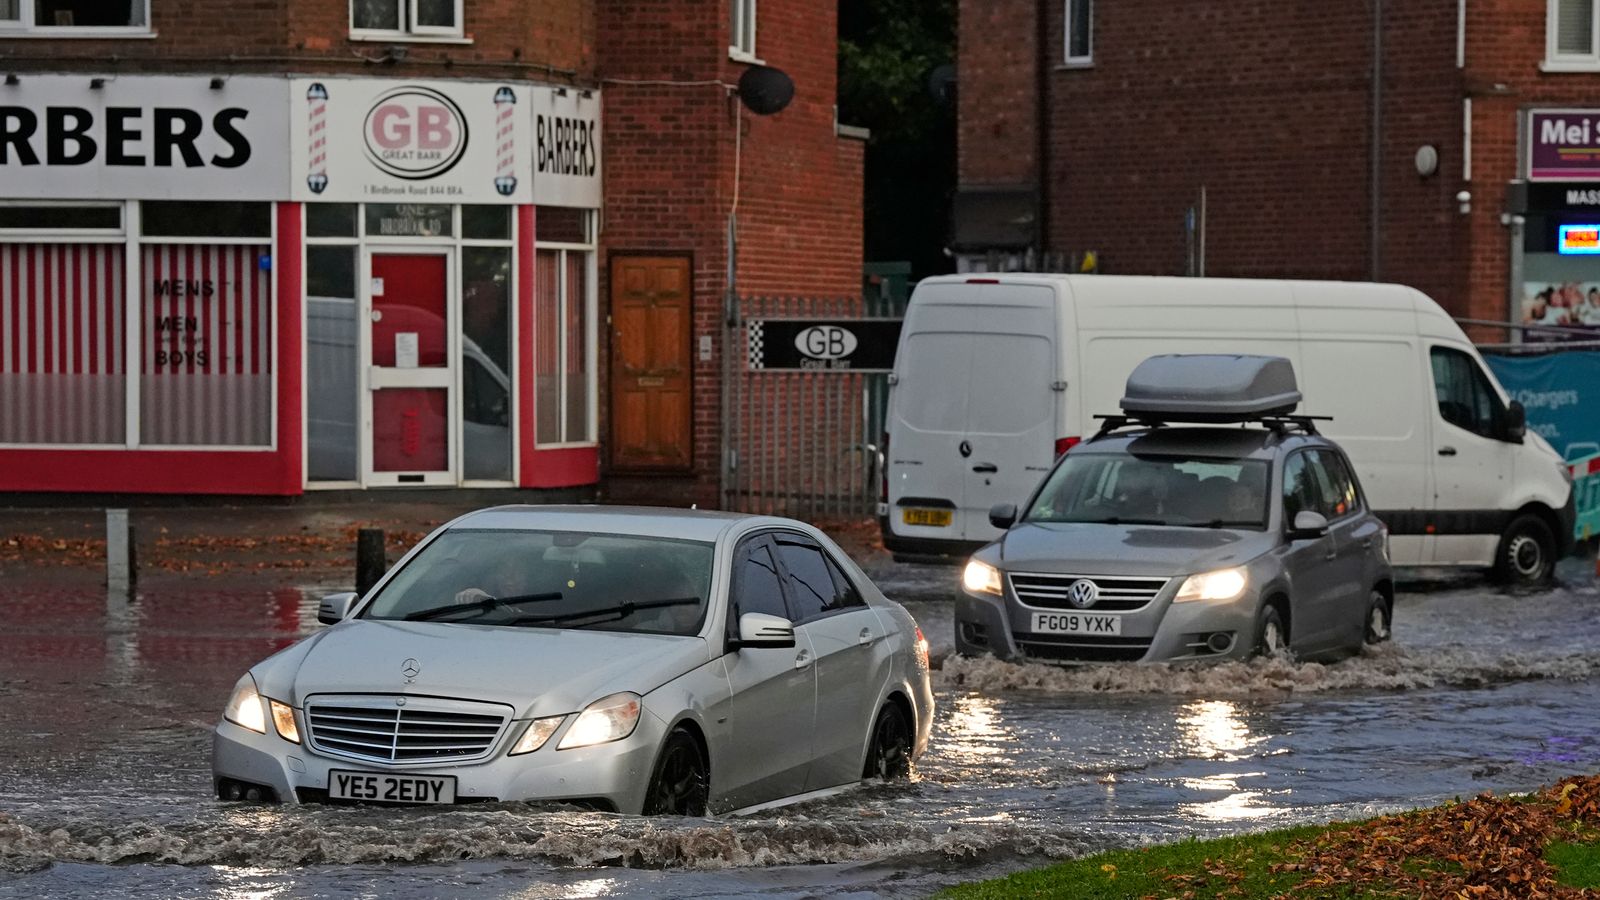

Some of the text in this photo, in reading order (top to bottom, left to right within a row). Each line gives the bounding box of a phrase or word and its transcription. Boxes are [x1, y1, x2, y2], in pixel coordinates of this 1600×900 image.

[371, 104, 453, 150] GB
[1541, 118, 1590, 145] Mei
[537, 114, 596, 177] BARBERS
[382, 151, 442, 160] GREAT BARR
[408, 185, 428, 195] Road
[154, 279, 214, 297] MENS
[155, 316, 198, 332] MEN
[806, 327, 845, 356] GB
[155, 350, 208, 367] BOYS
[1038, 615, 1115, 632] FG09 YXK
[384, 778, 444, 801] 2EDY
